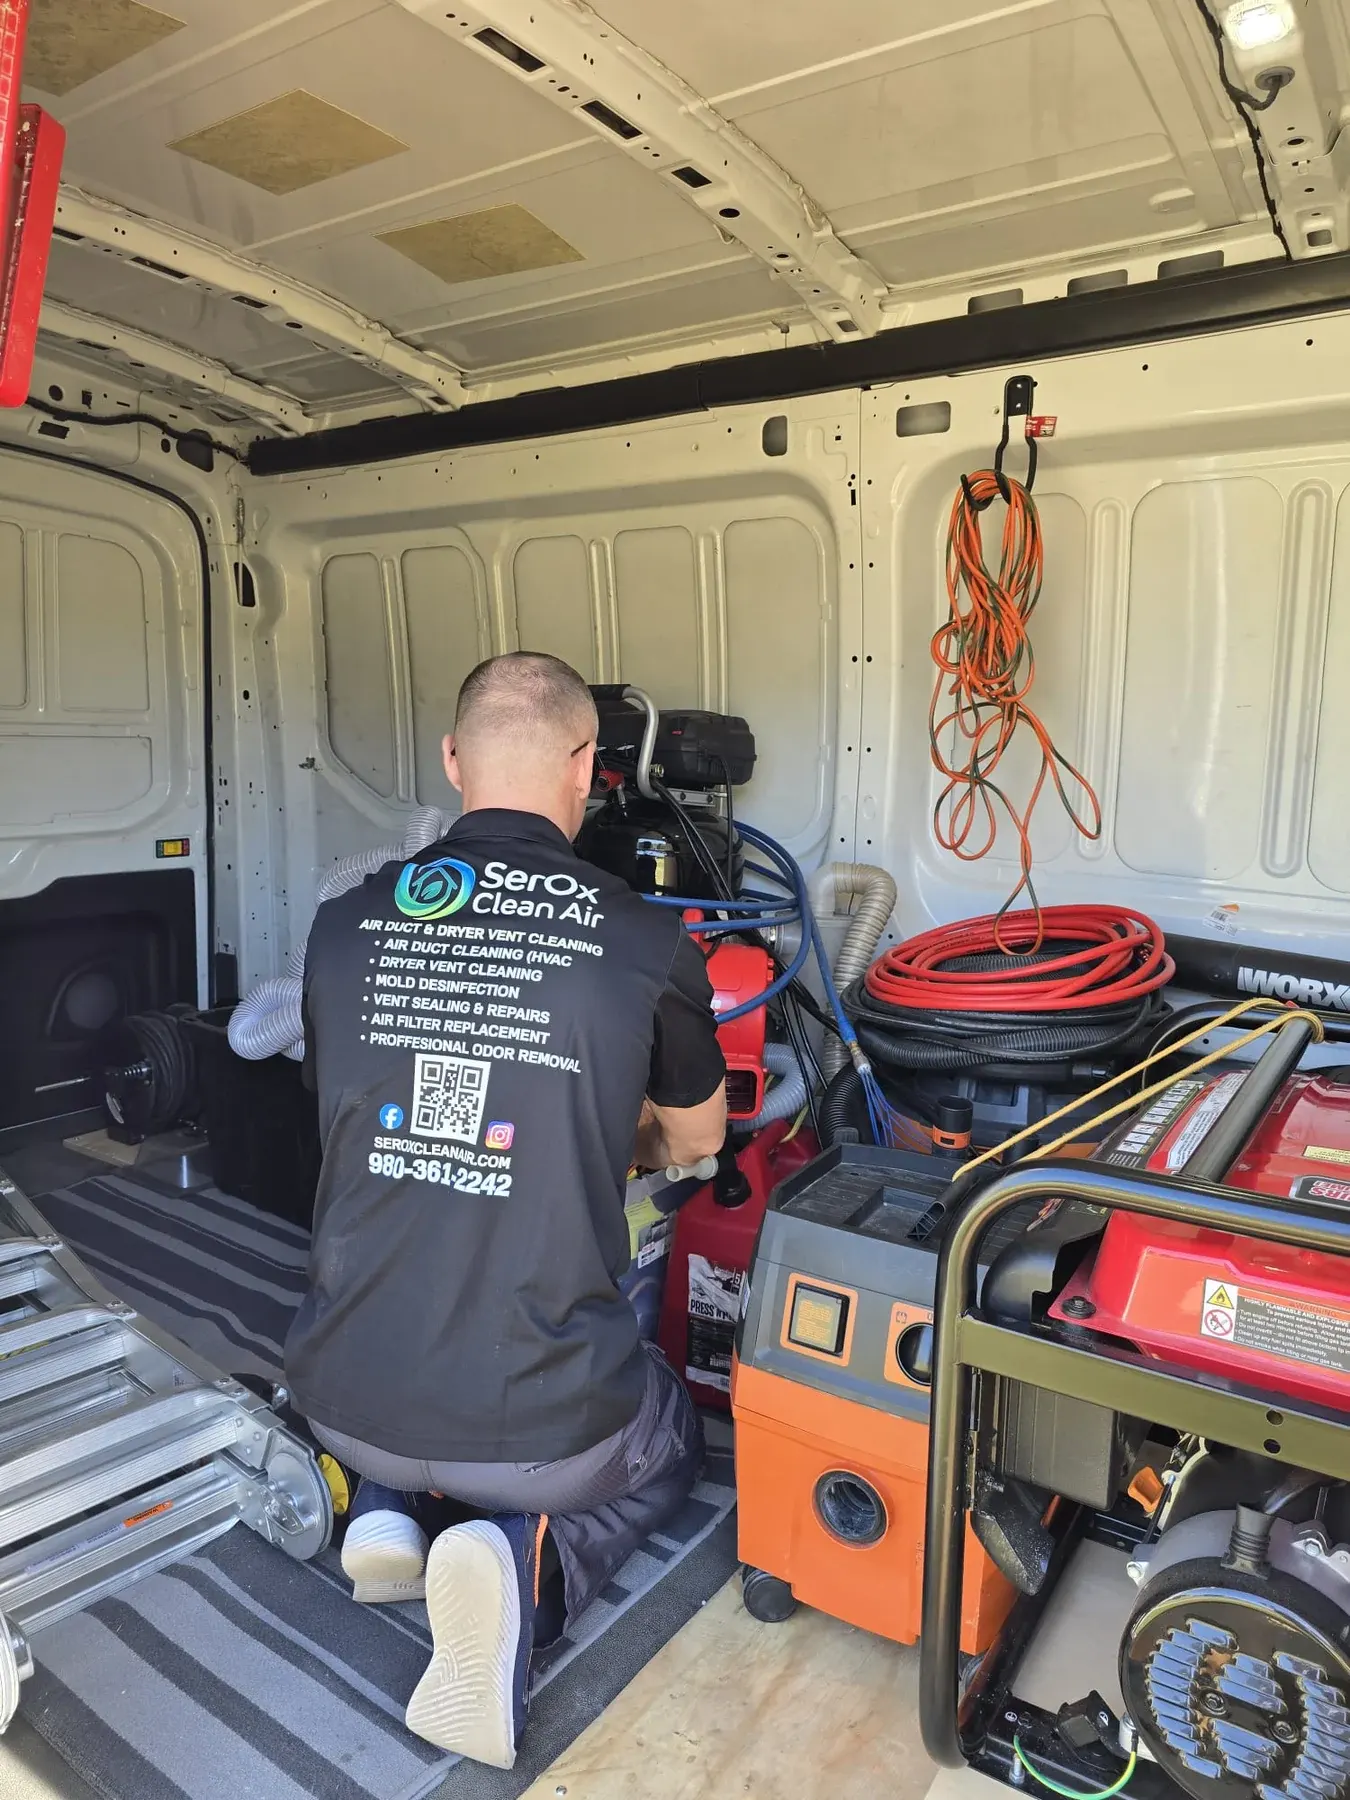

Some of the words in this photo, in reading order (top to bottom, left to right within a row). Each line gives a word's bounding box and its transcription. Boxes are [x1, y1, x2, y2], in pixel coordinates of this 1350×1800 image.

[479, 862, 600, 904] SerOx
[472, 892, 554, 918] Clean
[559, 902, 604, 928] Air
[359, 919, 383, 931] AIR
[384, 921, 422, 934] DUCT
[424, 924, 434, 935] &
[437, 925, 484, 940] DRYER
[488, 929, 526, 943] VENT
[528, 933, 603, 957] CLEANING
[384, 939, 408, 951] AIR
[411, 940, 449, 954] DUCT
[451, 944, 523, 960] CLEANING
[526, 951, 572, 967] (HVAC
[379, 956, 425, 970] DRYER
[429, 960, 466, 974] VENT
[468, 963, 542, 982] CLEANING
[376, 974, 416, 988] MOLD
[418, 979, 520, 999] DESINFECTION
[1237, 966, 1350, 1011] WORX
[374, 994, 409, 1007] VENT
[412, 997, 470, 1013] SEALING
[473, 1003, 483, 1015] &
[487, 1005, 550, 1024] REPAIRS
[371, 1013, 393, 1026] AIR
[397, 1015, 441, 1031] FILTER
[443, 1020, 550, 1044] REPLACEMENT
[370, 1032, 469, 1054] PROFFESIONAL
[472, 1043, 514, 1060] ODOR
[518, 1048, 581, 1073] REMOVAL
[374, 1137, 512, 1170] SEROXCLEANAIR.COM
[369, 1152, 512, 1197] 980-361-2242
[690, 1299, 715, 1317] PRESS
[1244, 1298, 1265, 1306] HIGHLY
[1266, 1303, 1301, 1316] FLAMMABLE
[1316, 1315, 1348, 1327] EXPLOSIVE
[1274, 1312, 1295, 1321] prevent
[1296, 1316, 1316, 1325] serious
[1317, 1321, 1334, 1330] injury
[1295, 1302, 1336, 1318] WARNING
[1276, 1325, 1296, 1334] minutes
[1297, 1329, 1314, 1338] before
[1315, 1334, 1328, 1342] filling
[1278, 1319, 1294, 1327] before
[1302, 1338, 1318, 1346] above
[1319, 1342, 1337, 1351] bottom
